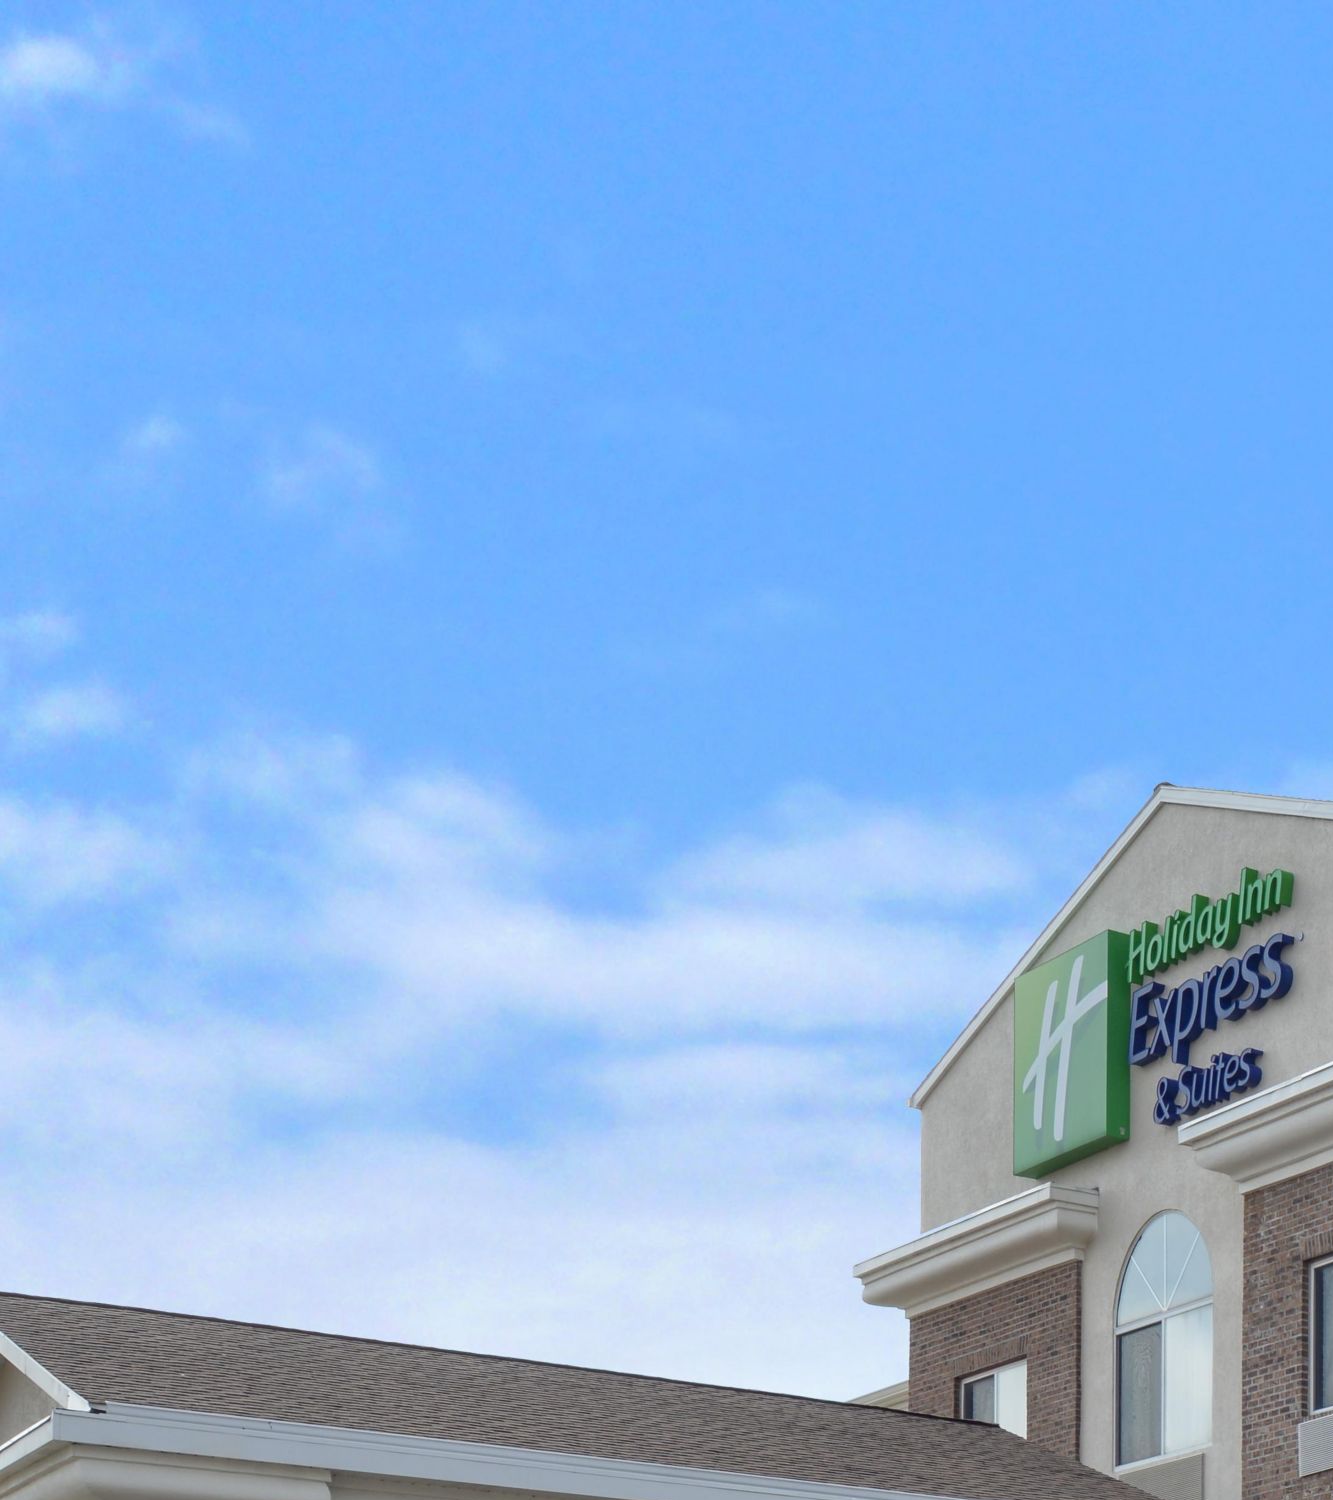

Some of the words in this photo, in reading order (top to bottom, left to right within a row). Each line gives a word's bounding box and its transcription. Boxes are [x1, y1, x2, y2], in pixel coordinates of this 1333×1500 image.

[1127, 892, 1238, 983] Holiday
[1238, 867, 1293, 926] Inn
[1129, 933, 1294, 1065] Express
[1153, 1077, 1179, 1125] &
[1177, 1048, 1263, 1115] Suites
